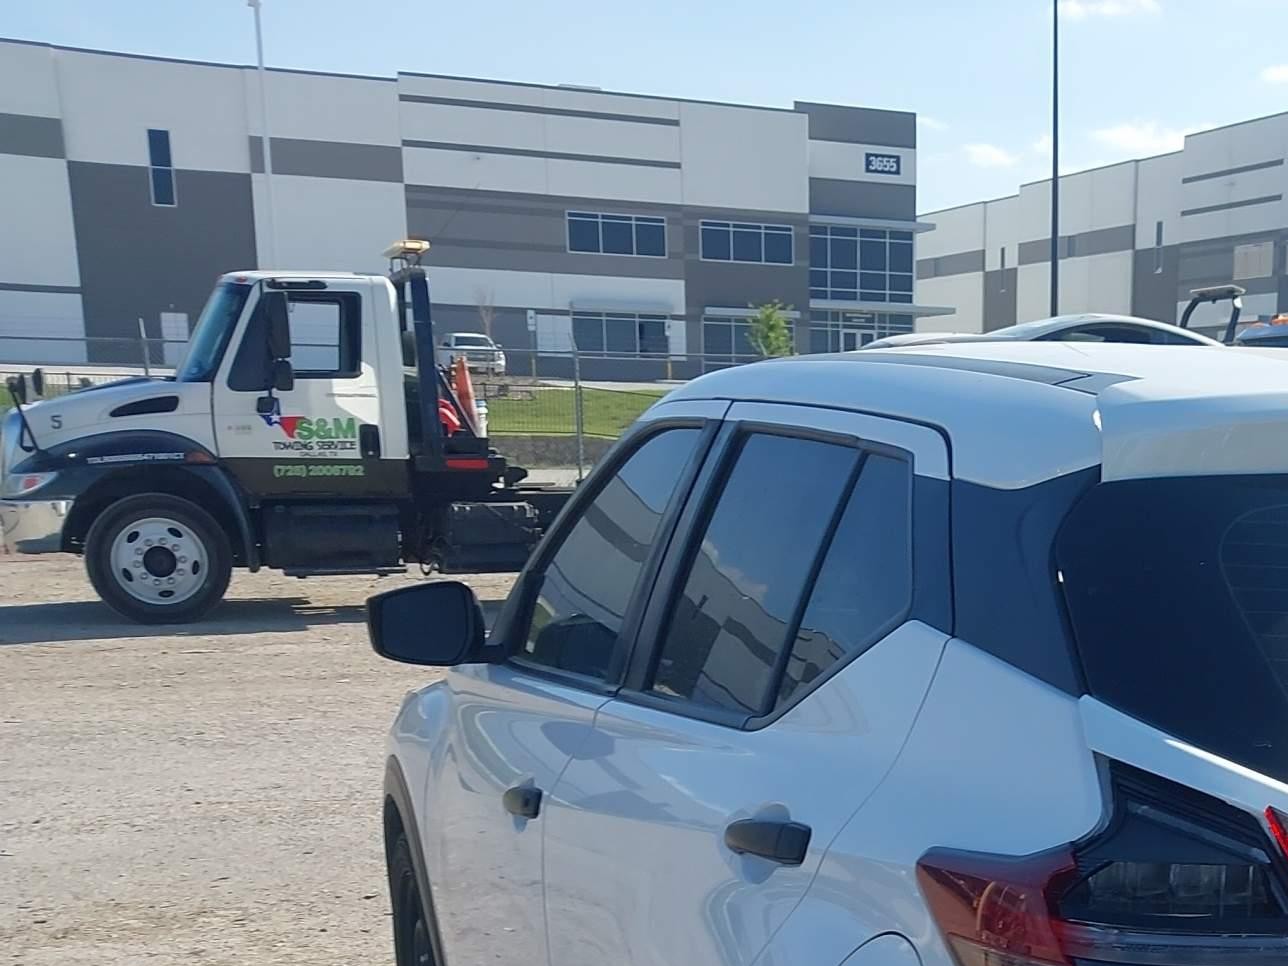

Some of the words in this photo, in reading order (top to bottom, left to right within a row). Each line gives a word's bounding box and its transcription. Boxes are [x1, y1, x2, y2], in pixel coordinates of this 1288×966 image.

[868, 156, 897, 172] 3655
[50, 414, 63, 430] 5
[297, 417, 357, 440] S&M
[272, 440, 314, 451] TOWING
[316, 440, 358, 451] SERVICE
